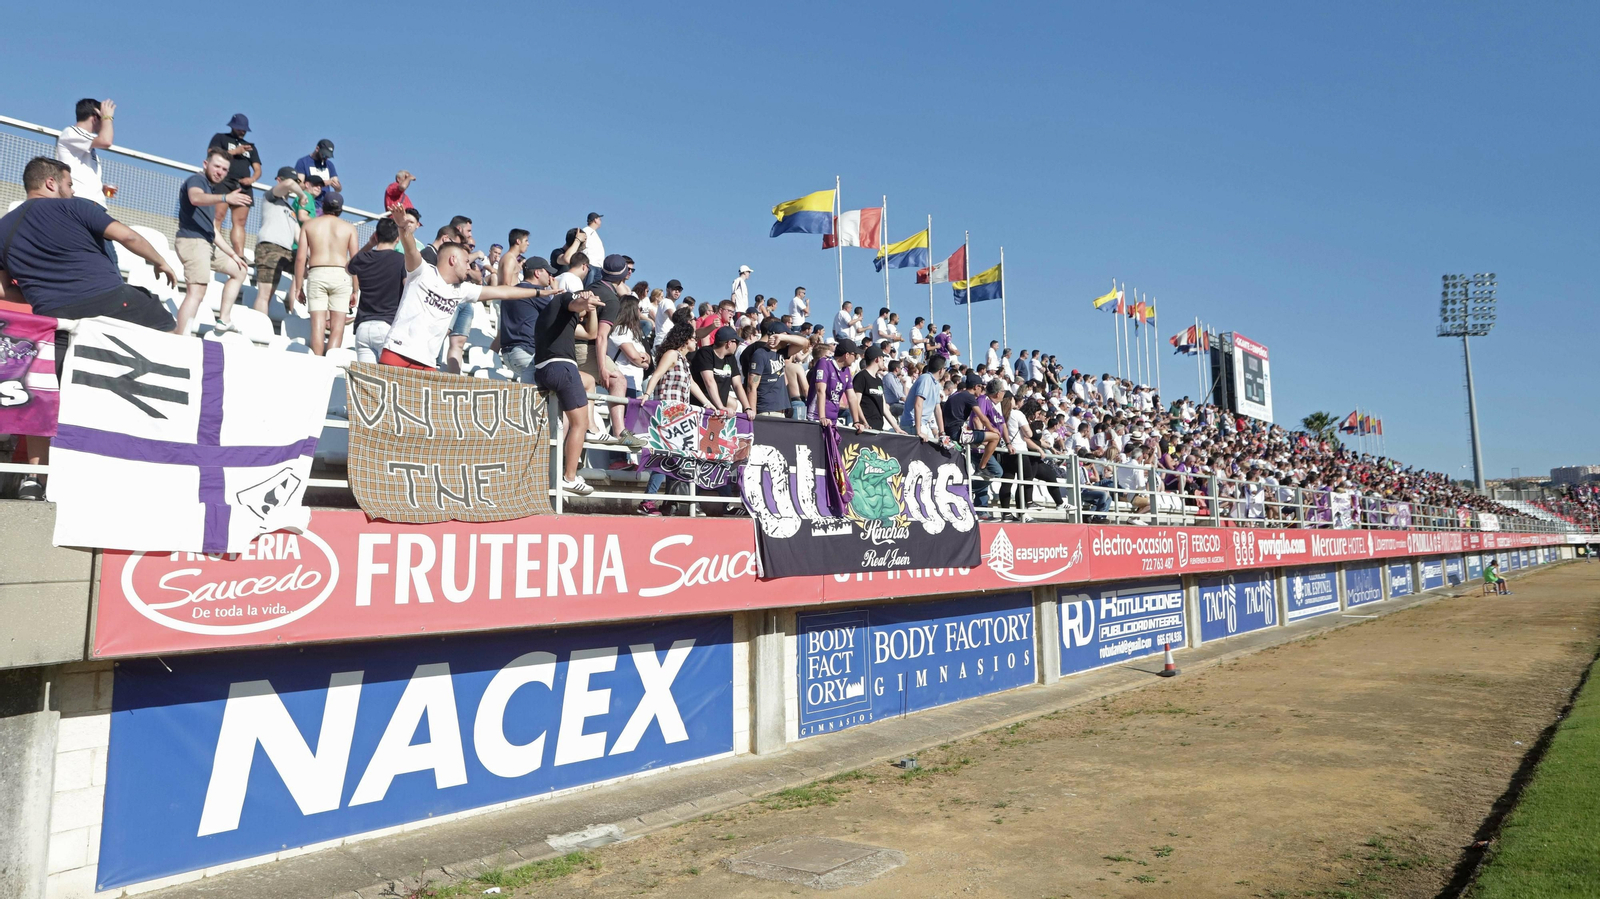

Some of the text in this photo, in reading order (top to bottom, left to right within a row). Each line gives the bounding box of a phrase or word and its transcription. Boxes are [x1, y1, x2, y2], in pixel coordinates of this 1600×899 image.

[665, 416, 698, 440] JAEN
[860, 519, 910, 546] Hinchas
[1093, 529, 1174, 556] electro-ocasión
[1191, 534, 1221, 553] FERGOD
[1311, 534, 1347, 557] Mercure
[1347, 537, 1366, 554] HOTEL
[861, 549, 887, 569] Real
[1016, 543, 1068, 563] easysports
[1257, 532, 1306, 562] yovigilo.com
[355, 533, 628, 606] FRUTERIA
[1142, 559, 1153, 571] 722
[147, 564, 322, 610] Saucedo
[1347, 588, 1381, 605] Manhattan
[192, 607, 211, 619] De
[215, 605, 243, 617] toda
[247, 604, 258, 616] la
[807, 626, 857, 654] BODY
[874, 612, 1032, 664] BODY FACTORY
[1101, 614, 1182, 639] PUBLICIDAD INTEGRAL
[807, 650, 854, 680] FACT
[874, 649, 1030, 696] GIMNASIOS
[807, 678, 848, 706] ORY
[197, 638, 697, 837] NACEX
[801, 712, 874, 736] GIMNASIOS
